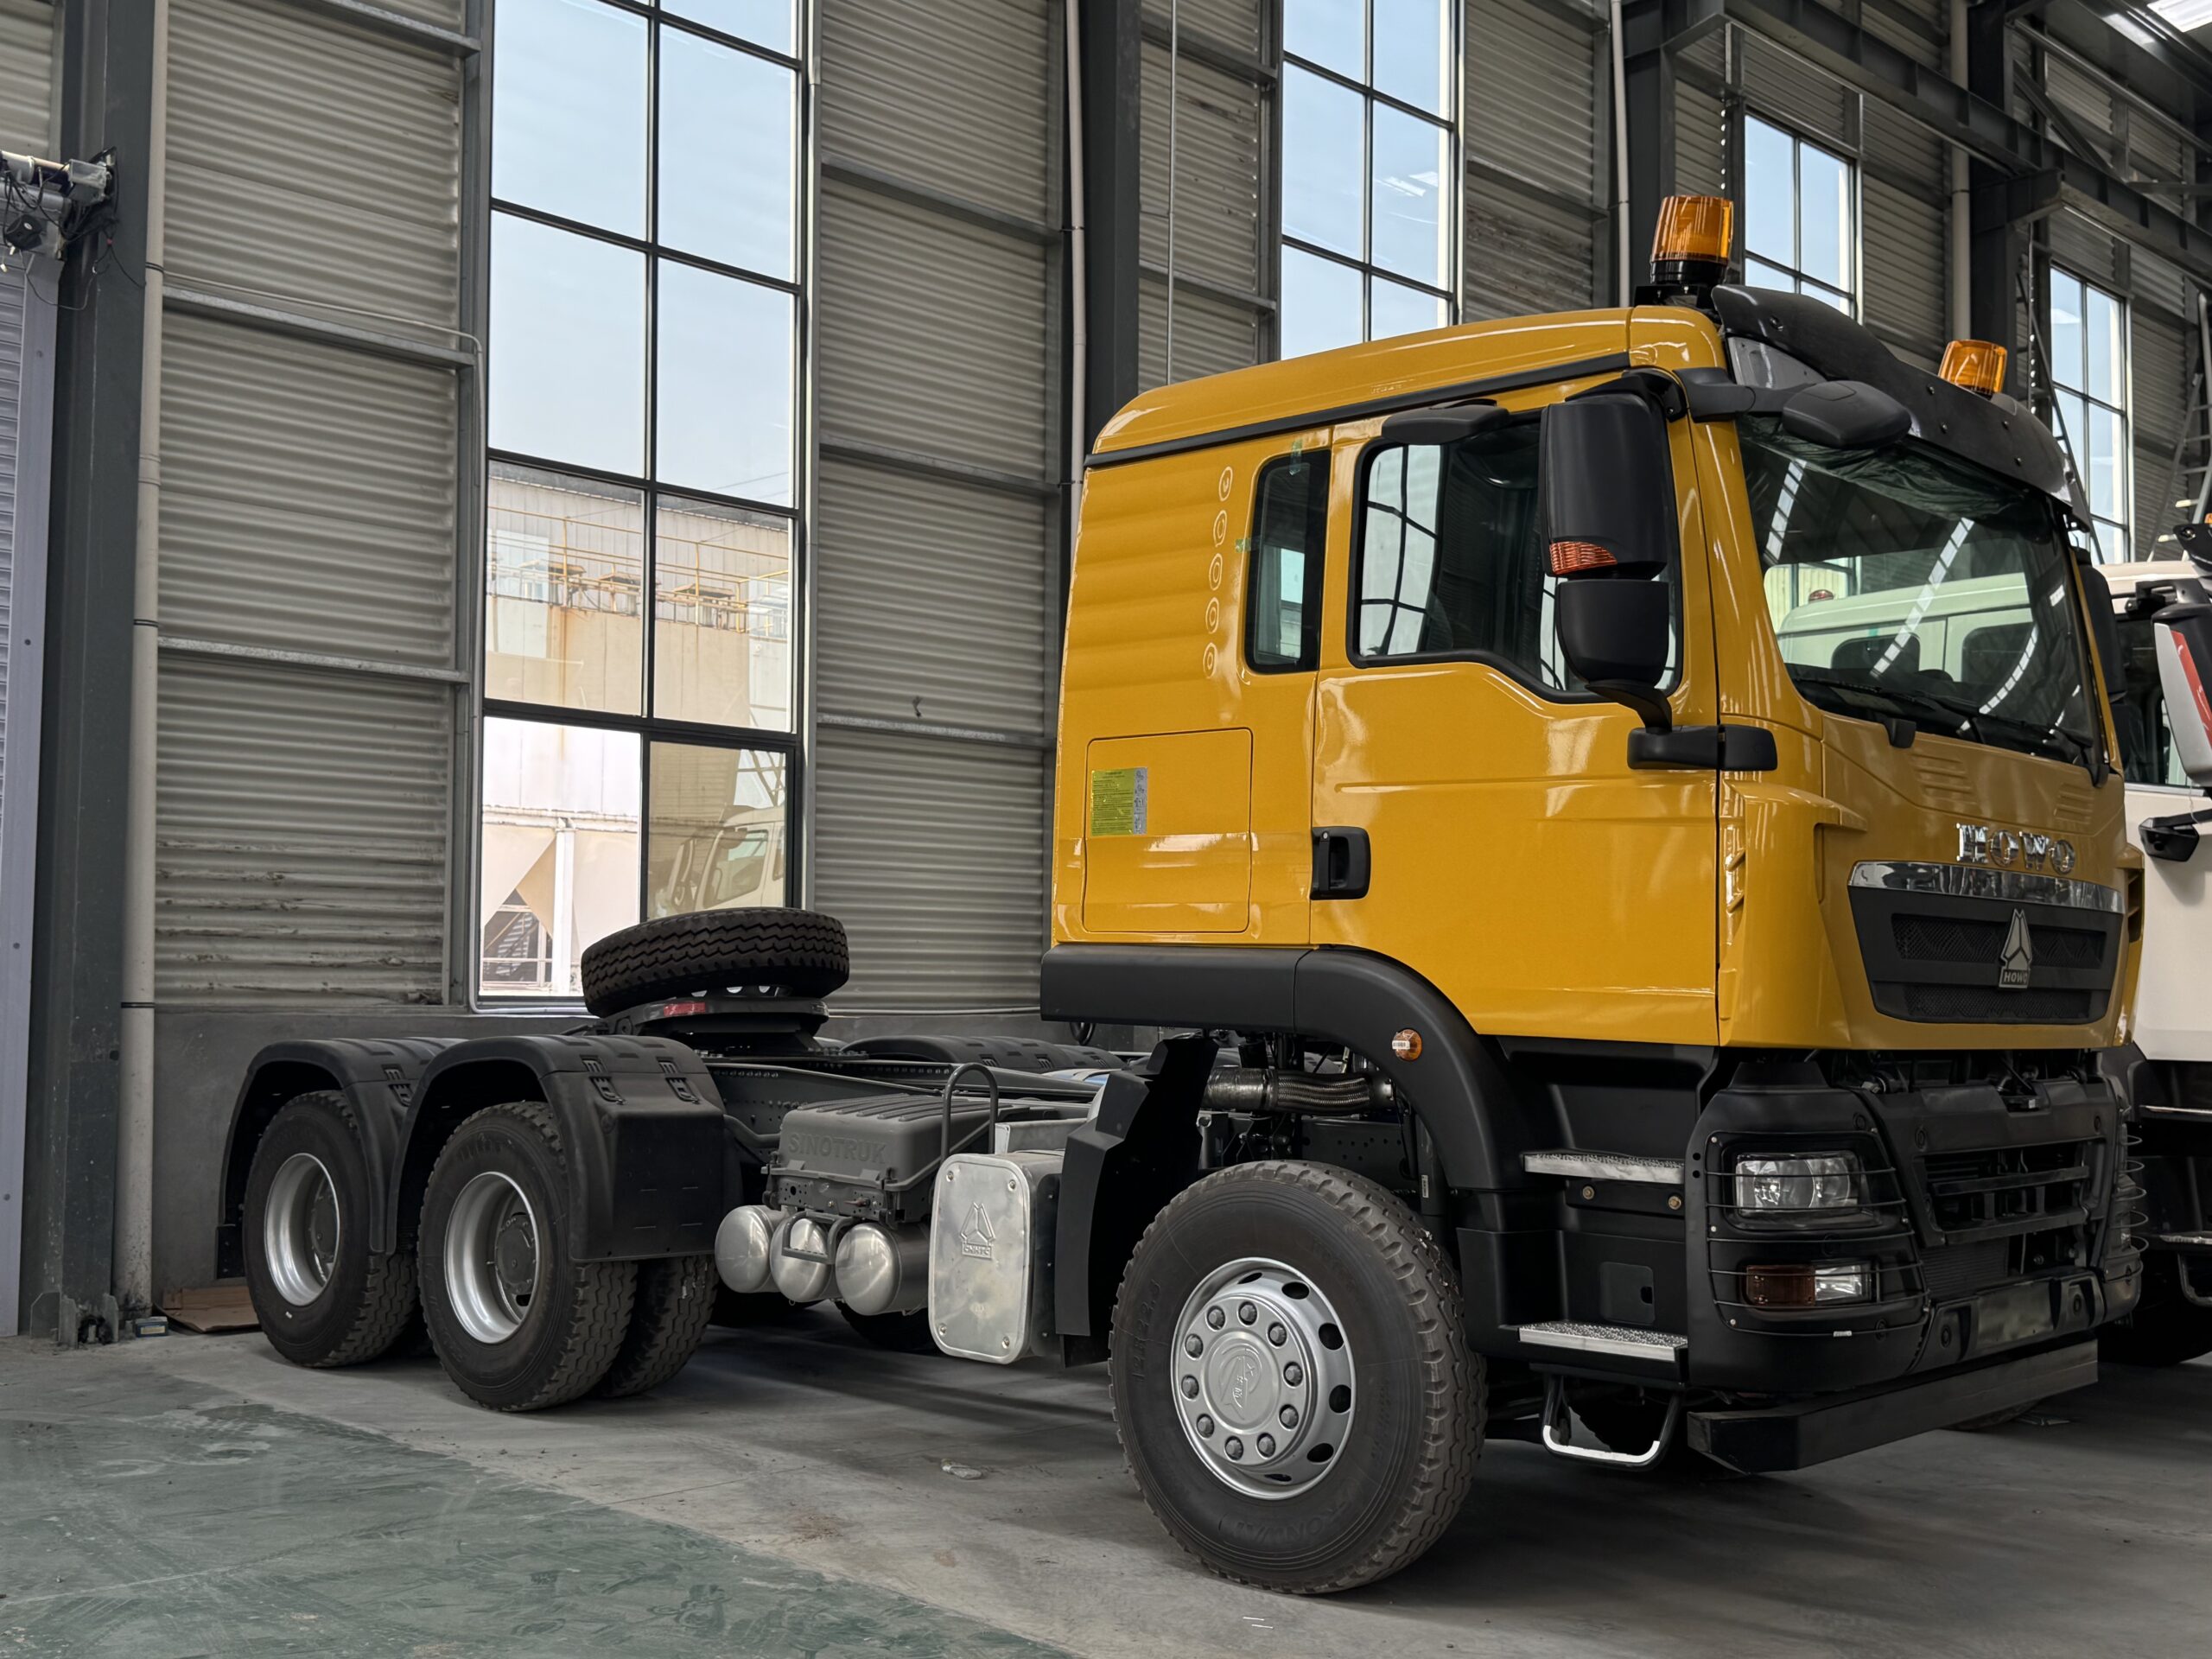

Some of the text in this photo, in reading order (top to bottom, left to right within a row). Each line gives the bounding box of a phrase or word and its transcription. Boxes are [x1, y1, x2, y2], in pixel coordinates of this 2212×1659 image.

[1956, 823, 2075, 874] HOWO
[2003, 972, 2028, 983] HOWO
[788, 1132, 887, 1165] SINOTRUK
